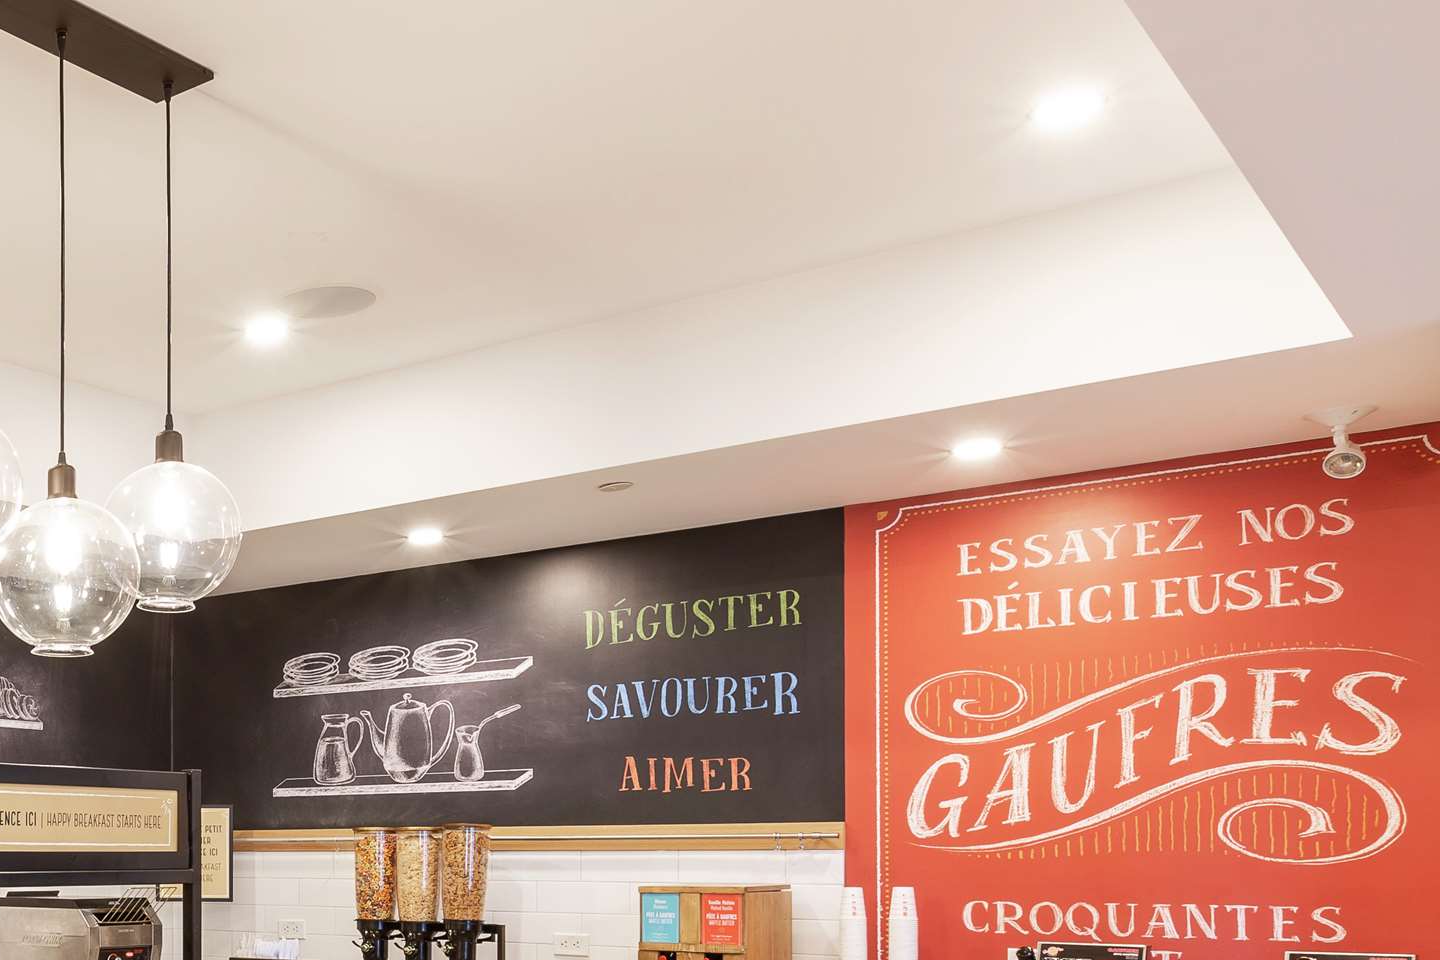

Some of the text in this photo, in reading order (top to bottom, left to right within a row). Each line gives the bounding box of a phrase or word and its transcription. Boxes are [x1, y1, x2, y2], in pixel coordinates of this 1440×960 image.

[956, 498, 1355, 576] ESSAYEZ NOS
[583, 589, 802, 650] DÉGUSTER
[957, 562, 1344, 635] DÉLICIEUSES
[586, 671, 800, 722] SAVOURER
[618, 756, 753, 792] AIMER
[906, 667, 1408, 839] GAUFRES
[25, 811, 37, 826] ICI
[47, 812, 72, 828] HAPPY
[73, 813, 114, 828] BREAKFAST
[116, 814, 142, 829] STARTS
[144, 815, 161, 830] HERE
[204, 825, 222, 833] PETIT
[209, 848, 218, 857] ICI
[962, 899, 1348, 943] CROQUANTES
